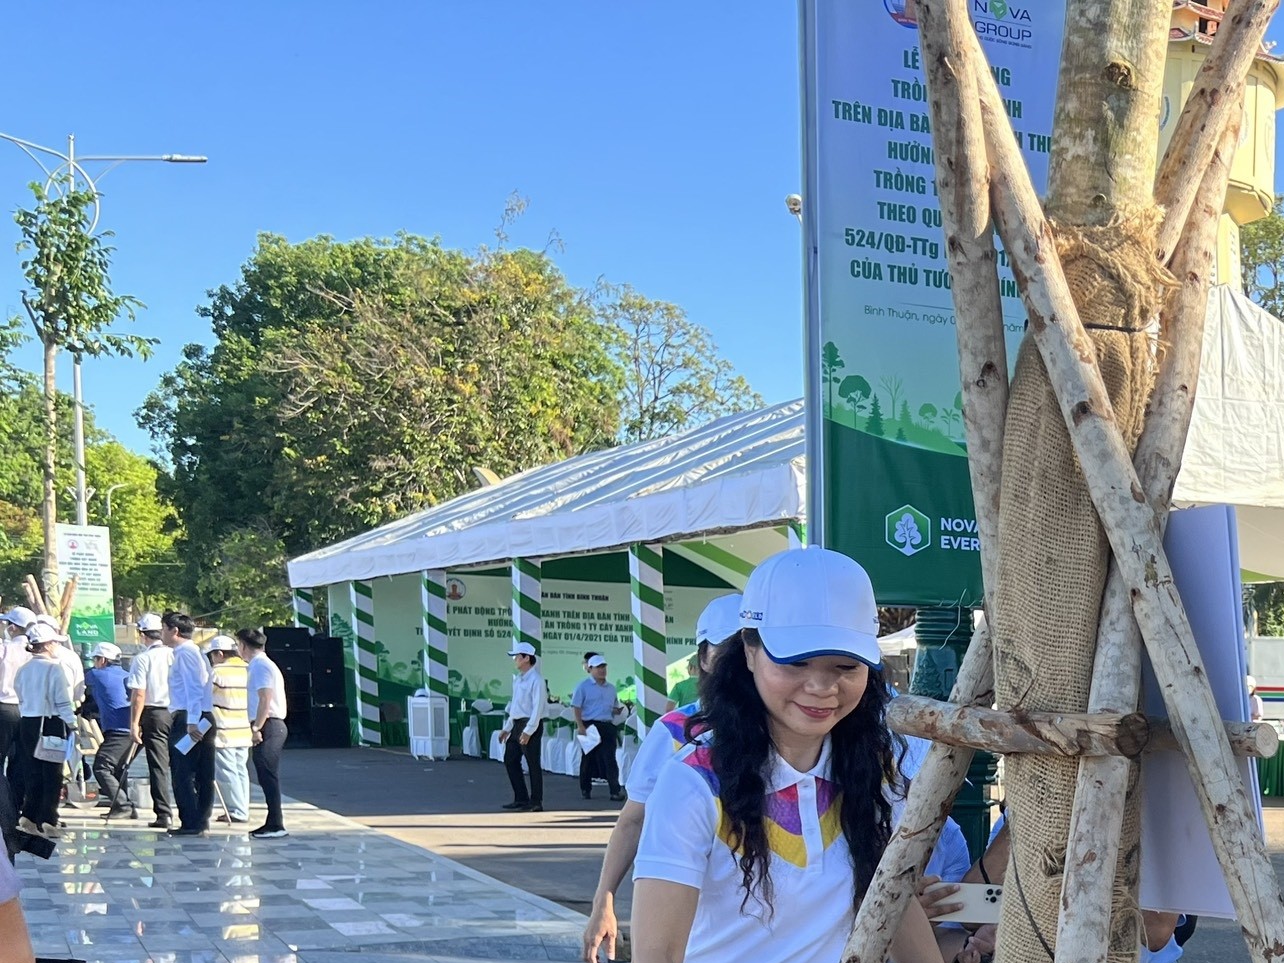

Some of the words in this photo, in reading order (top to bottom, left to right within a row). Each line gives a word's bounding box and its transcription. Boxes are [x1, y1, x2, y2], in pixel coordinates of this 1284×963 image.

[974, 21, 1032, 41] GROUP
[903, 45, 920, 70] LỄ
[832, 99, 872, 125] TRÊN
[877, 108, 905, 132] ĐỊA
[910, 112, 931, 134] BÀ
[873, 167, 926, 195] TRỒNG
[877, 201, 917, 224] THEO
[844, 228, 939, 260] 524/QĐ-TTg
[850, 257, 883, 281] CỦA
[887, 263, 918, 286] THỦ
[922, 312, 948, 326] ngày
